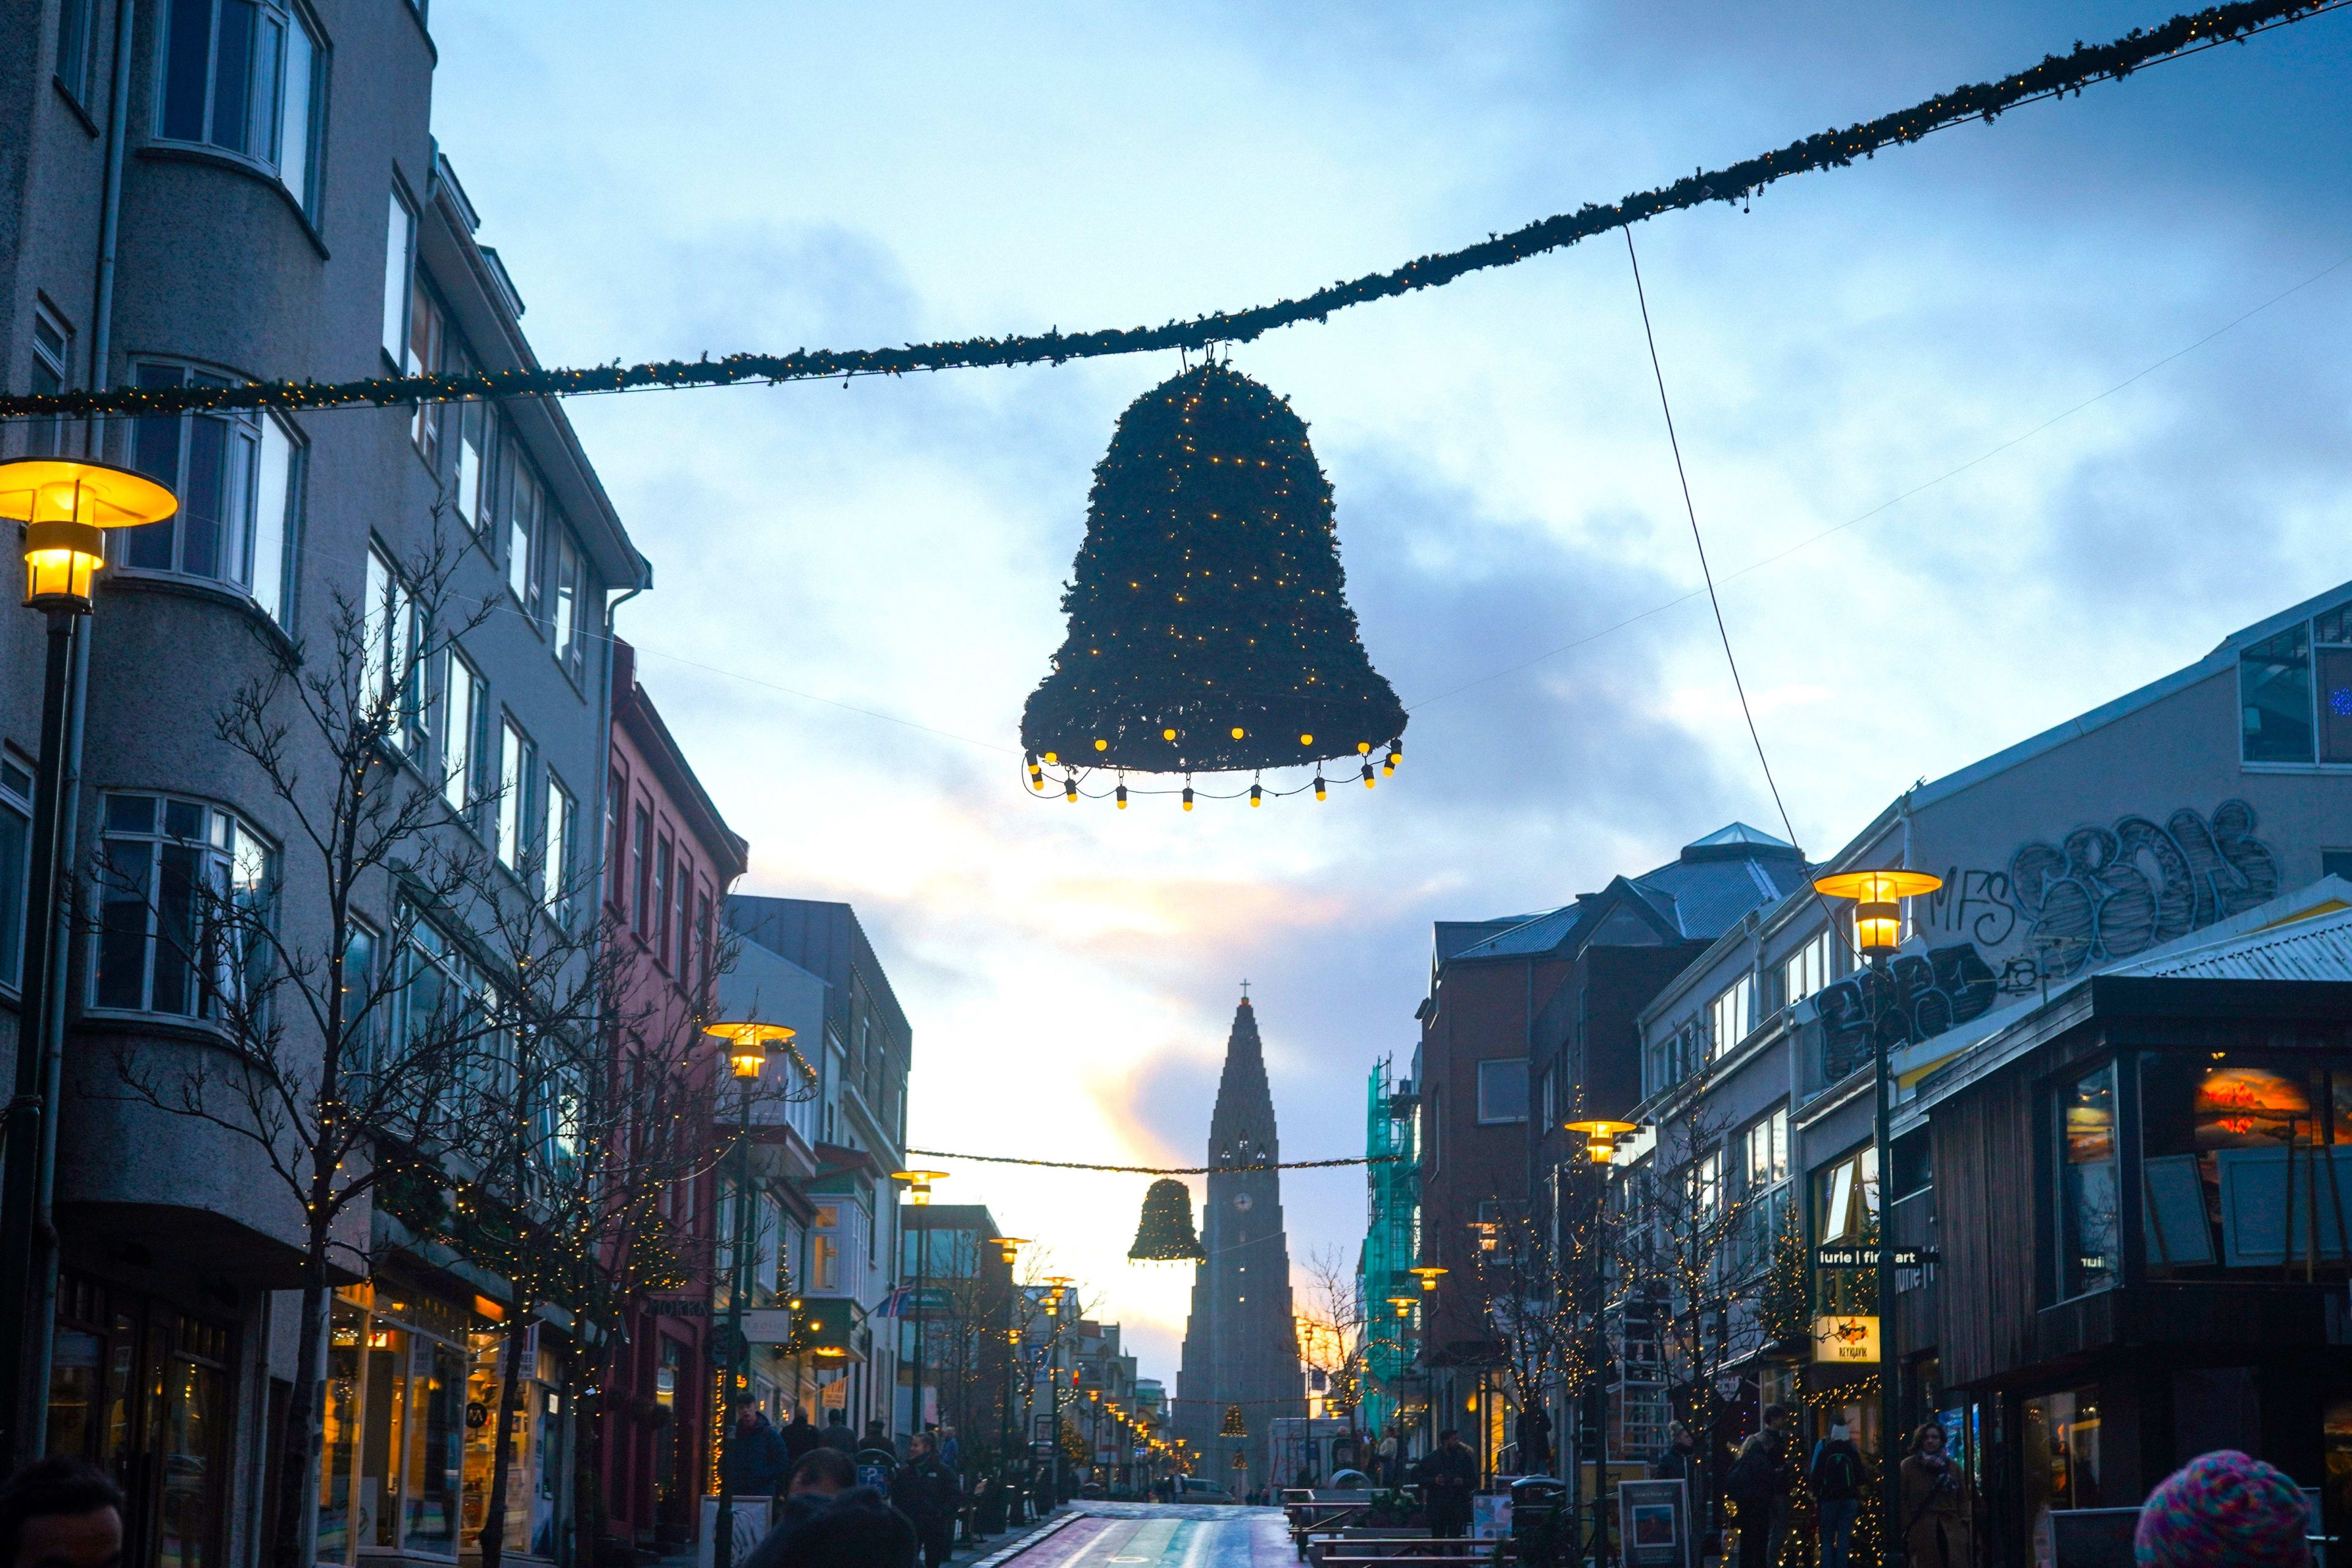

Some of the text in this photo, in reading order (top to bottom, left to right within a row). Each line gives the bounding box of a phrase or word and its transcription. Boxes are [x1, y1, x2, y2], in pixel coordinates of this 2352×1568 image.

[1929, 865, 2016, 947] MFS
[1820, 1251, 1852, 1264] iurie
[1894, 1252, 1916, 1264] art
